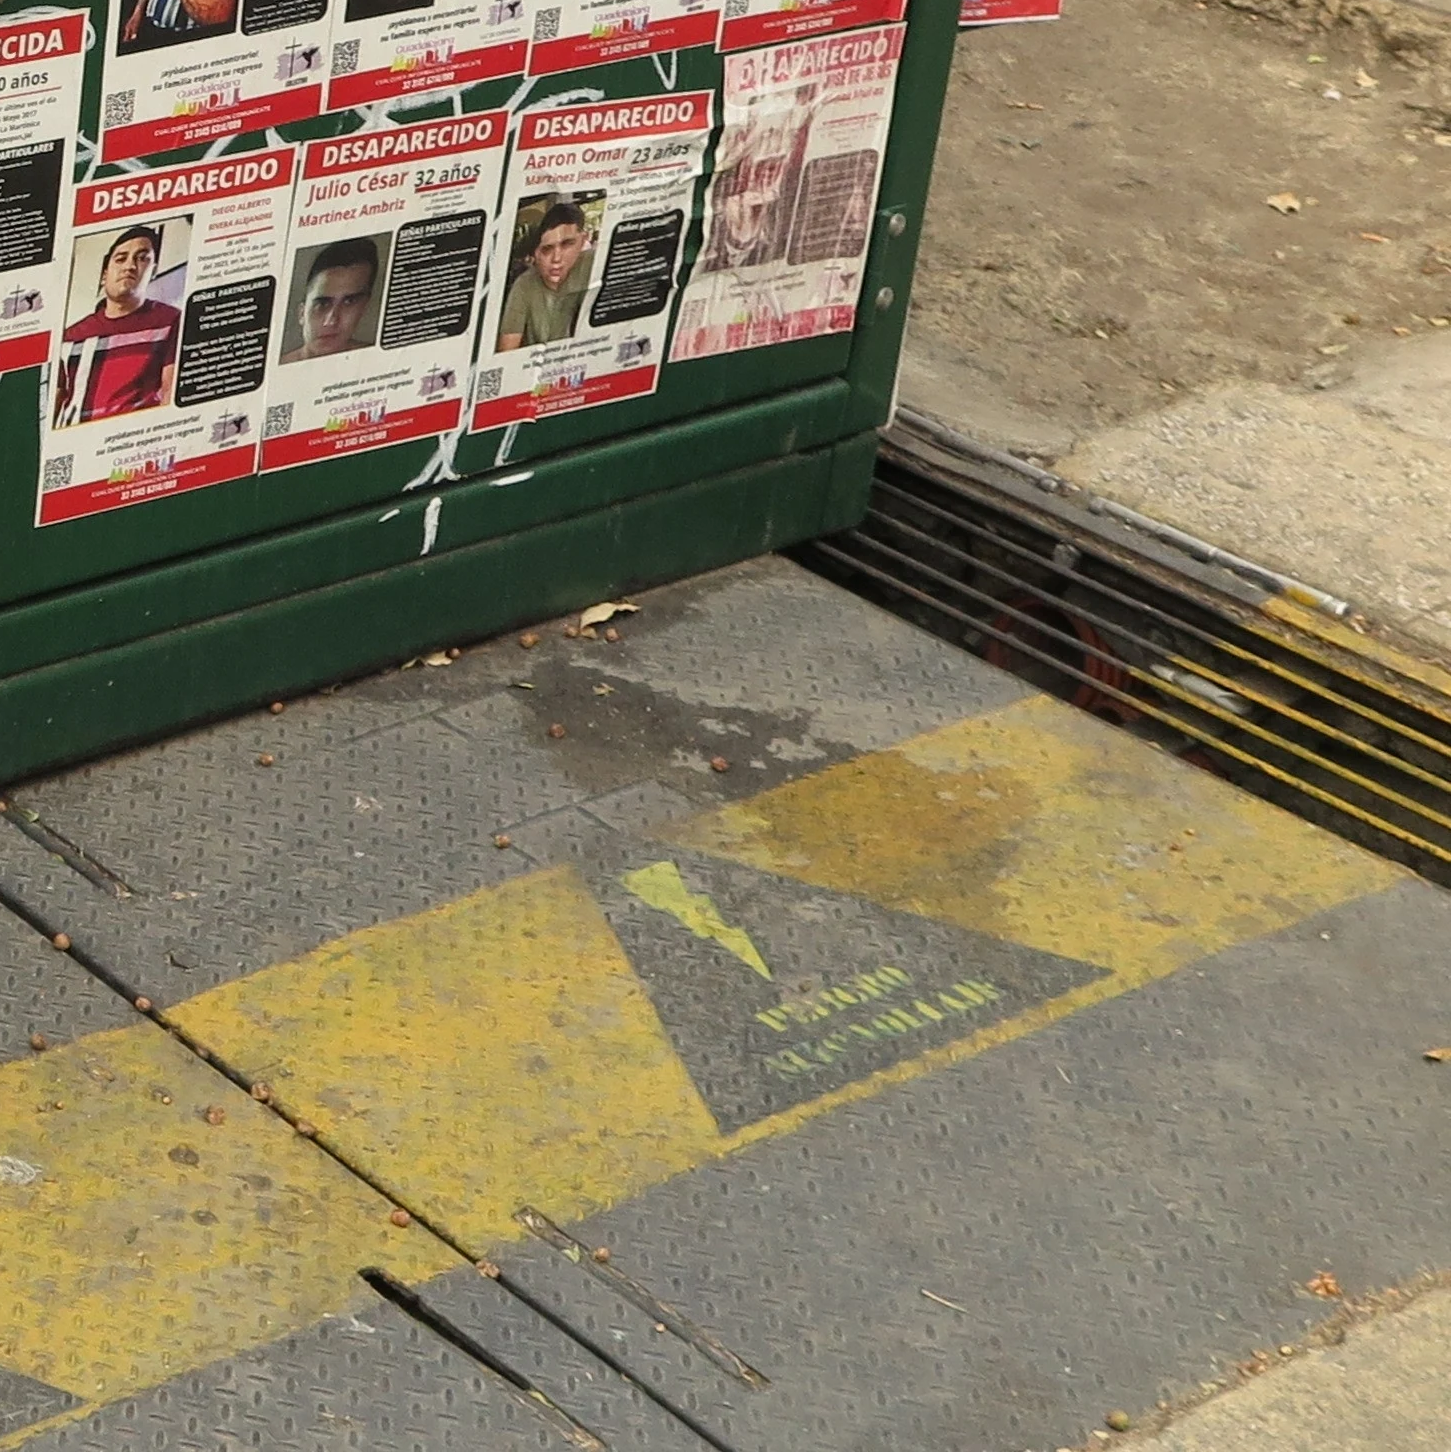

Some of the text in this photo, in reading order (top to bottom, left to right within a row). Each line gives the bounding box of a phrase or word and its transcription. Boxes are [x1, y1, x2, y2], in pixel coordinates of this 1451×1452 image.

[10, 70, 49, 89] años
[534, 100, 694, 141] DESAPARECIDO
[322, 118, 493, 168] DESAPARECIDO
[93, 158, 278, 214] DESAPARECIDO
[306, 168, 409, 207] Julio César
[413, 161, 481, 189] 32 años
